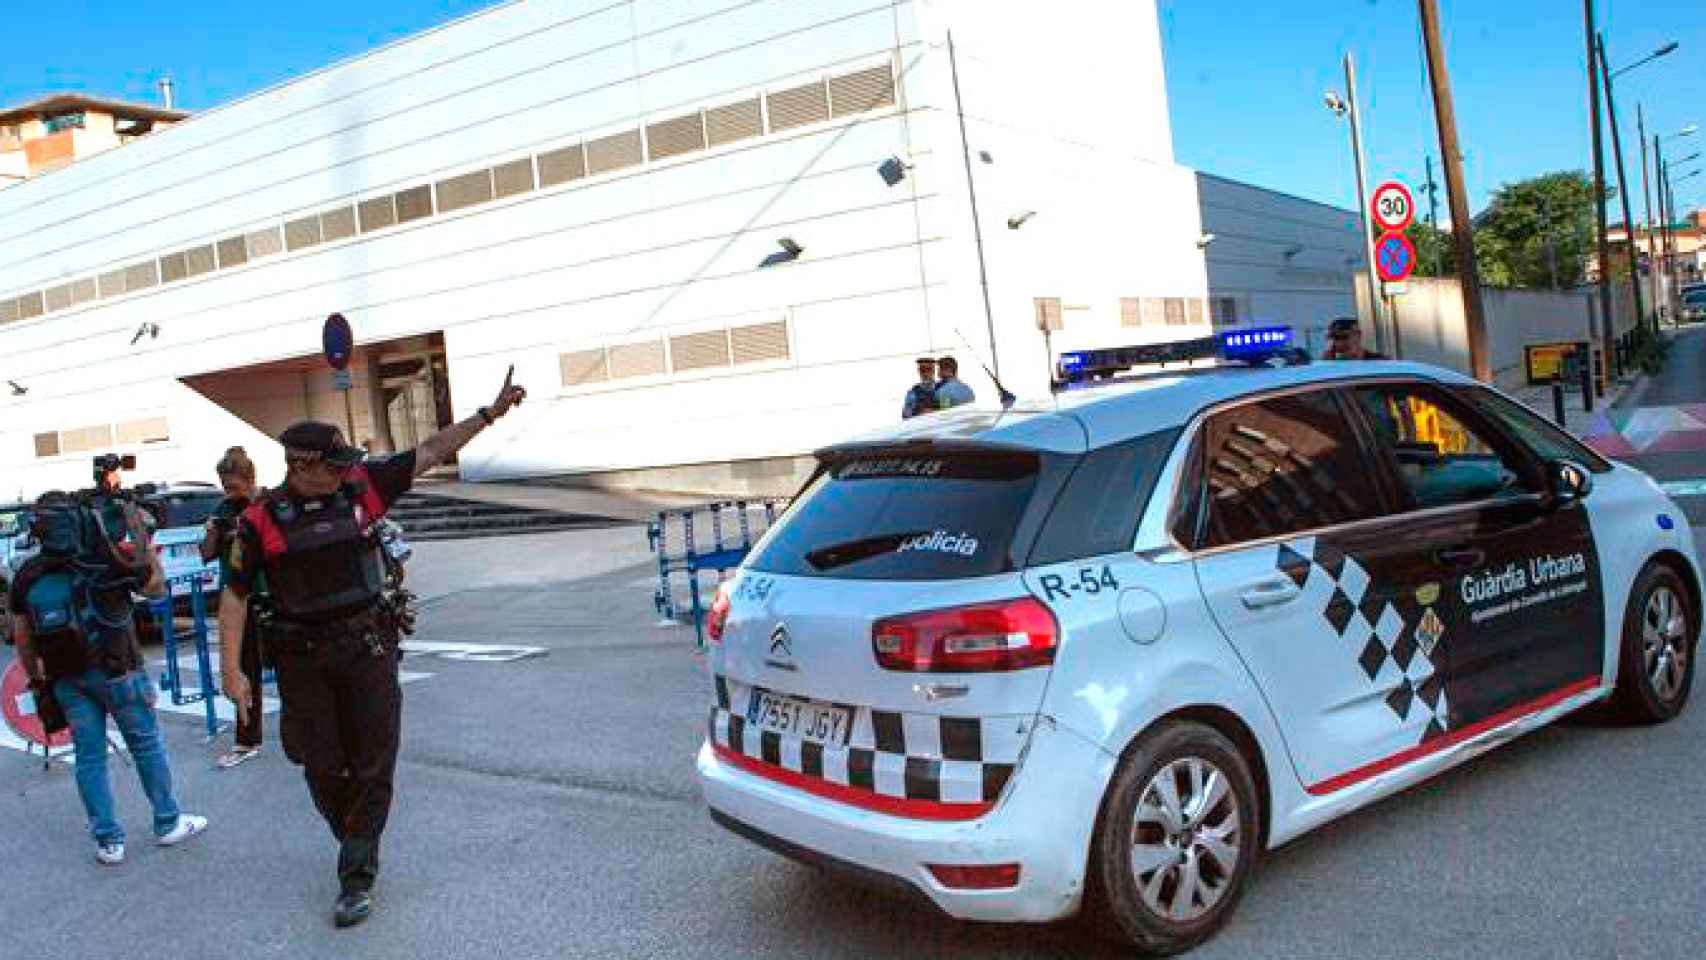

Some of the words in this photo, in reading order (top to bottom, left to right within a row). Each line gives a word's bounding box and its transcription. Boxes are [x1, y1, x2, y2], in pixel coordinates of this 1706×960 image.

[1381, 196, 1405, 216] 30
[1040, 564, 1119, 602] R-54
[1529, 553, 1585, 585] Urbana
